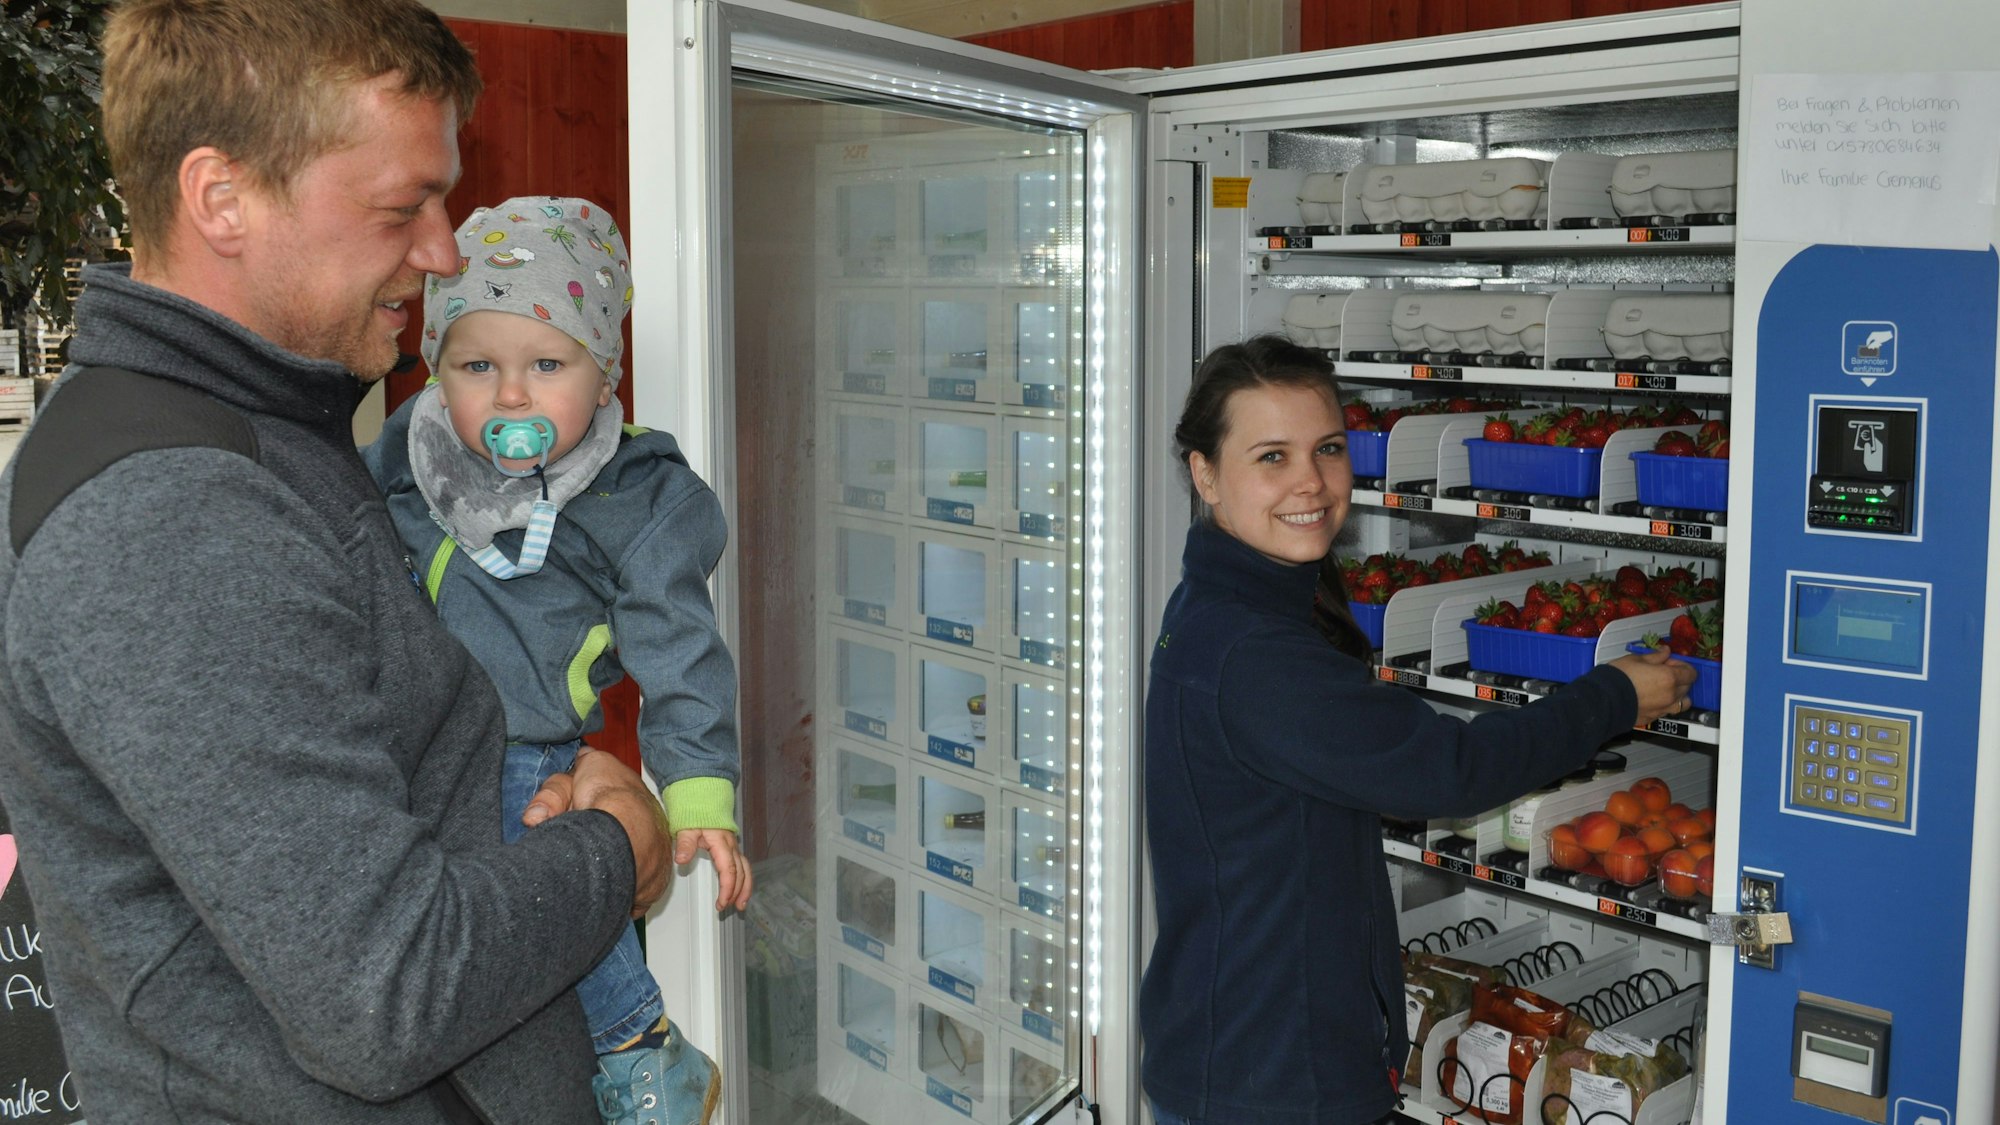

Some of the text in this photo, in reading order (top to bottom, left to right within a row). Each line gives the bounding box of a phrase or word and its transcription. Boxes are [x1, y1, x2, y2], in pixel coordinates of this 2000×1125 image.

[1777, 96, 1960, 117] Bei Fragen & Problemen
[1776, 119, 1831, 134] melden
[1836, 120, 1857, 134] Sie
[1912, 119, 1948, 134] bitte
[1775, 138, 1817, 153] unter
[1781, 168, 1810, 185] Ihre
[1818, 168, 1869, 187] Familie
[1402, 234, 1443, 246] 003 4.00
[1630, 229, 1680, 241] 007 4.00
[1851, 357, 1888, 366] Banknoten
[1413, 367, 1455, 379] 013 4.00
[1617, 375, 1666, 388] 017 4.00
[1478, 506, 1522, 519] 025 3.00
[1652, 523, 1701, 538] 028 3.00
[1380, 668, 1393, 680] 034
[1477, 687, 1520, 704] 035 3.00
[1657, 721, 1678, 735] 3.00
[1809, 719, 1816, 731] 1
[1828, 723, 1836, 734] 2
[1849, 727, 1857, 737] 3
[930, 740, 943, 753] 142
[1808, 742, 1815, 753] 4
[1828, 745, 1835, 756] 5
[1849, 750, 1856, 760] 6
[1806, 765, 1814, 775] 7
[1827, 768, 1834, 778] 8
[1848, 771, 1855, 781] 9
[929, 857, 941, 869] 152
[1474, 866, 1489, 878] 046
[1600, 901, 1647, 922] 047 2.50
[930, 970, 944, 984] 162
